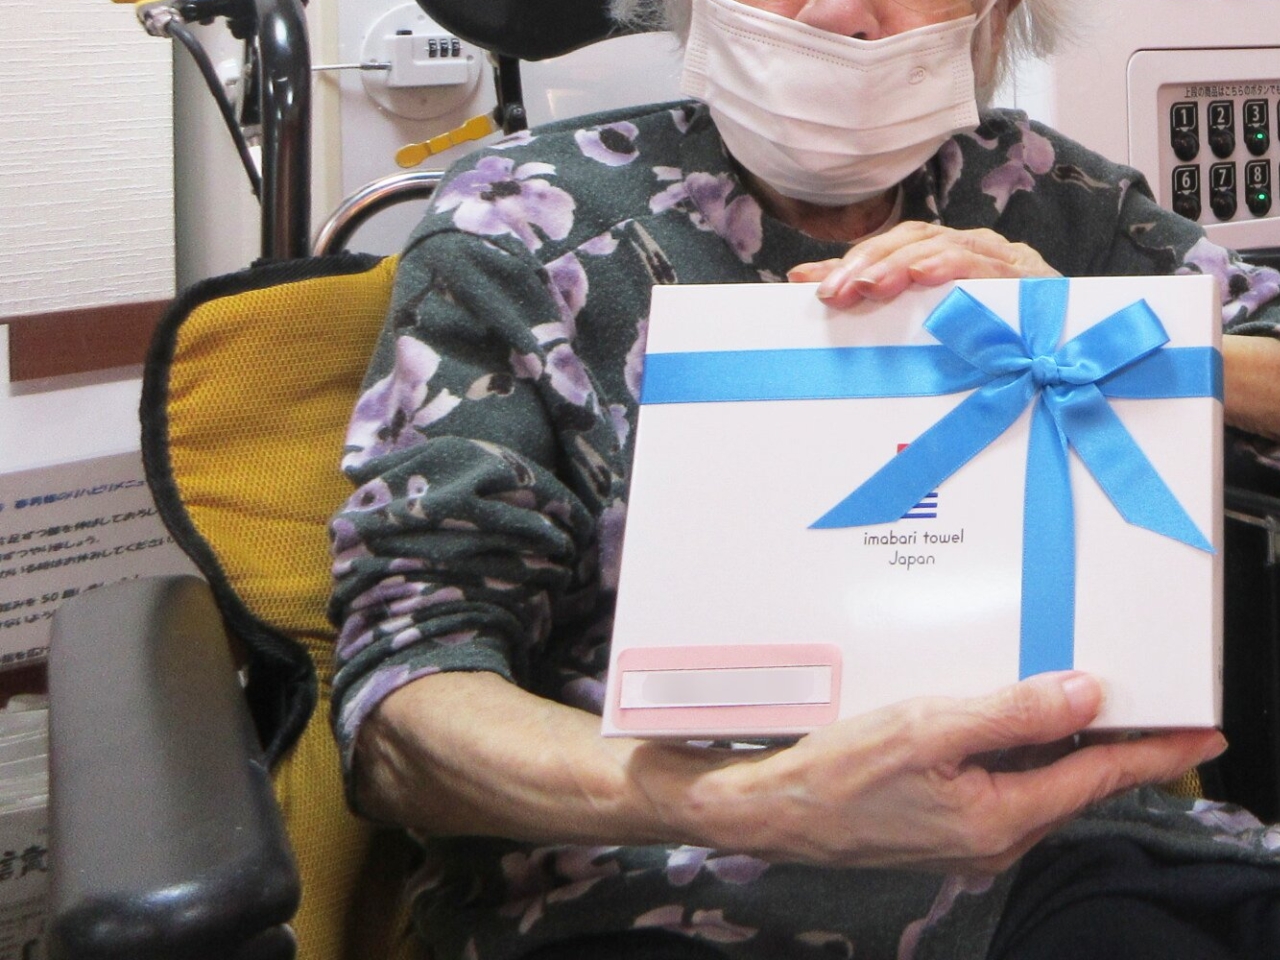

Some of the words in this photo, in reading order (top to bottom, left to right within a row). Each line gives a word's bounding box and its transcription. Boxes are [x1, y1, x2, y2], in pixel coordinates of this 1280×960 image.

[1180, 108, 1188, 125] 1
[1217, 107, 1225, 123] 2
[1252, 105, 1260, 121] 3
[1182, 172, 1191, 188] 6
[1218, 169, 1227, 185] 7
[1254, 166, 1262, 182] 8
[863, 530, 917, 545] imabari
[923, 528, 964, 544] towel
[888, 550, 935, 571] Japan
